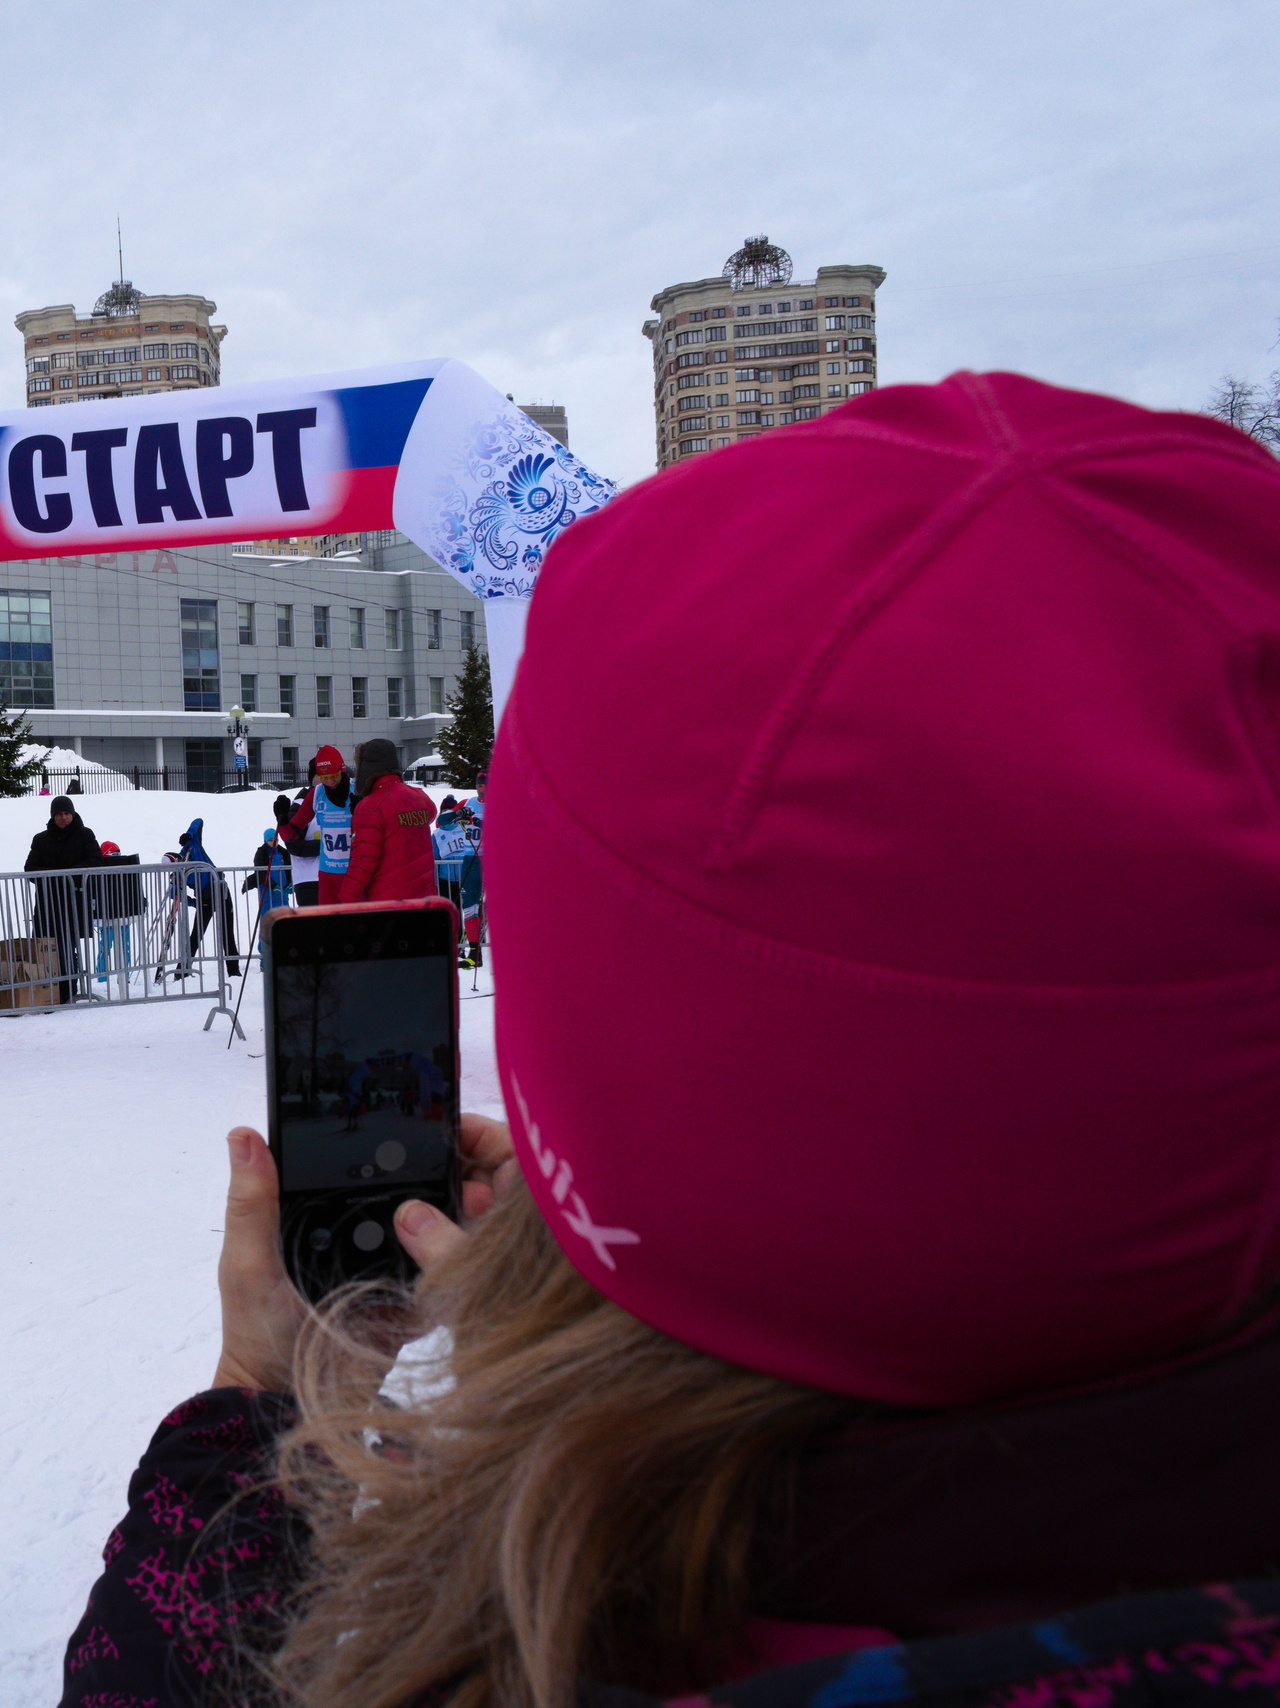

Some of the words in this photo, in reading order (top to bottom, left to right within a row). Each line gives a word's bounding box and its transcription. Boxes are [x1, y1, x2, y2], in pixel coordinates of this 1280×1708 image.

[8, 407, 317, 534] СТАРТ
[324, 833, 352, 852] 64
[447, 838, 465, 852] 116
